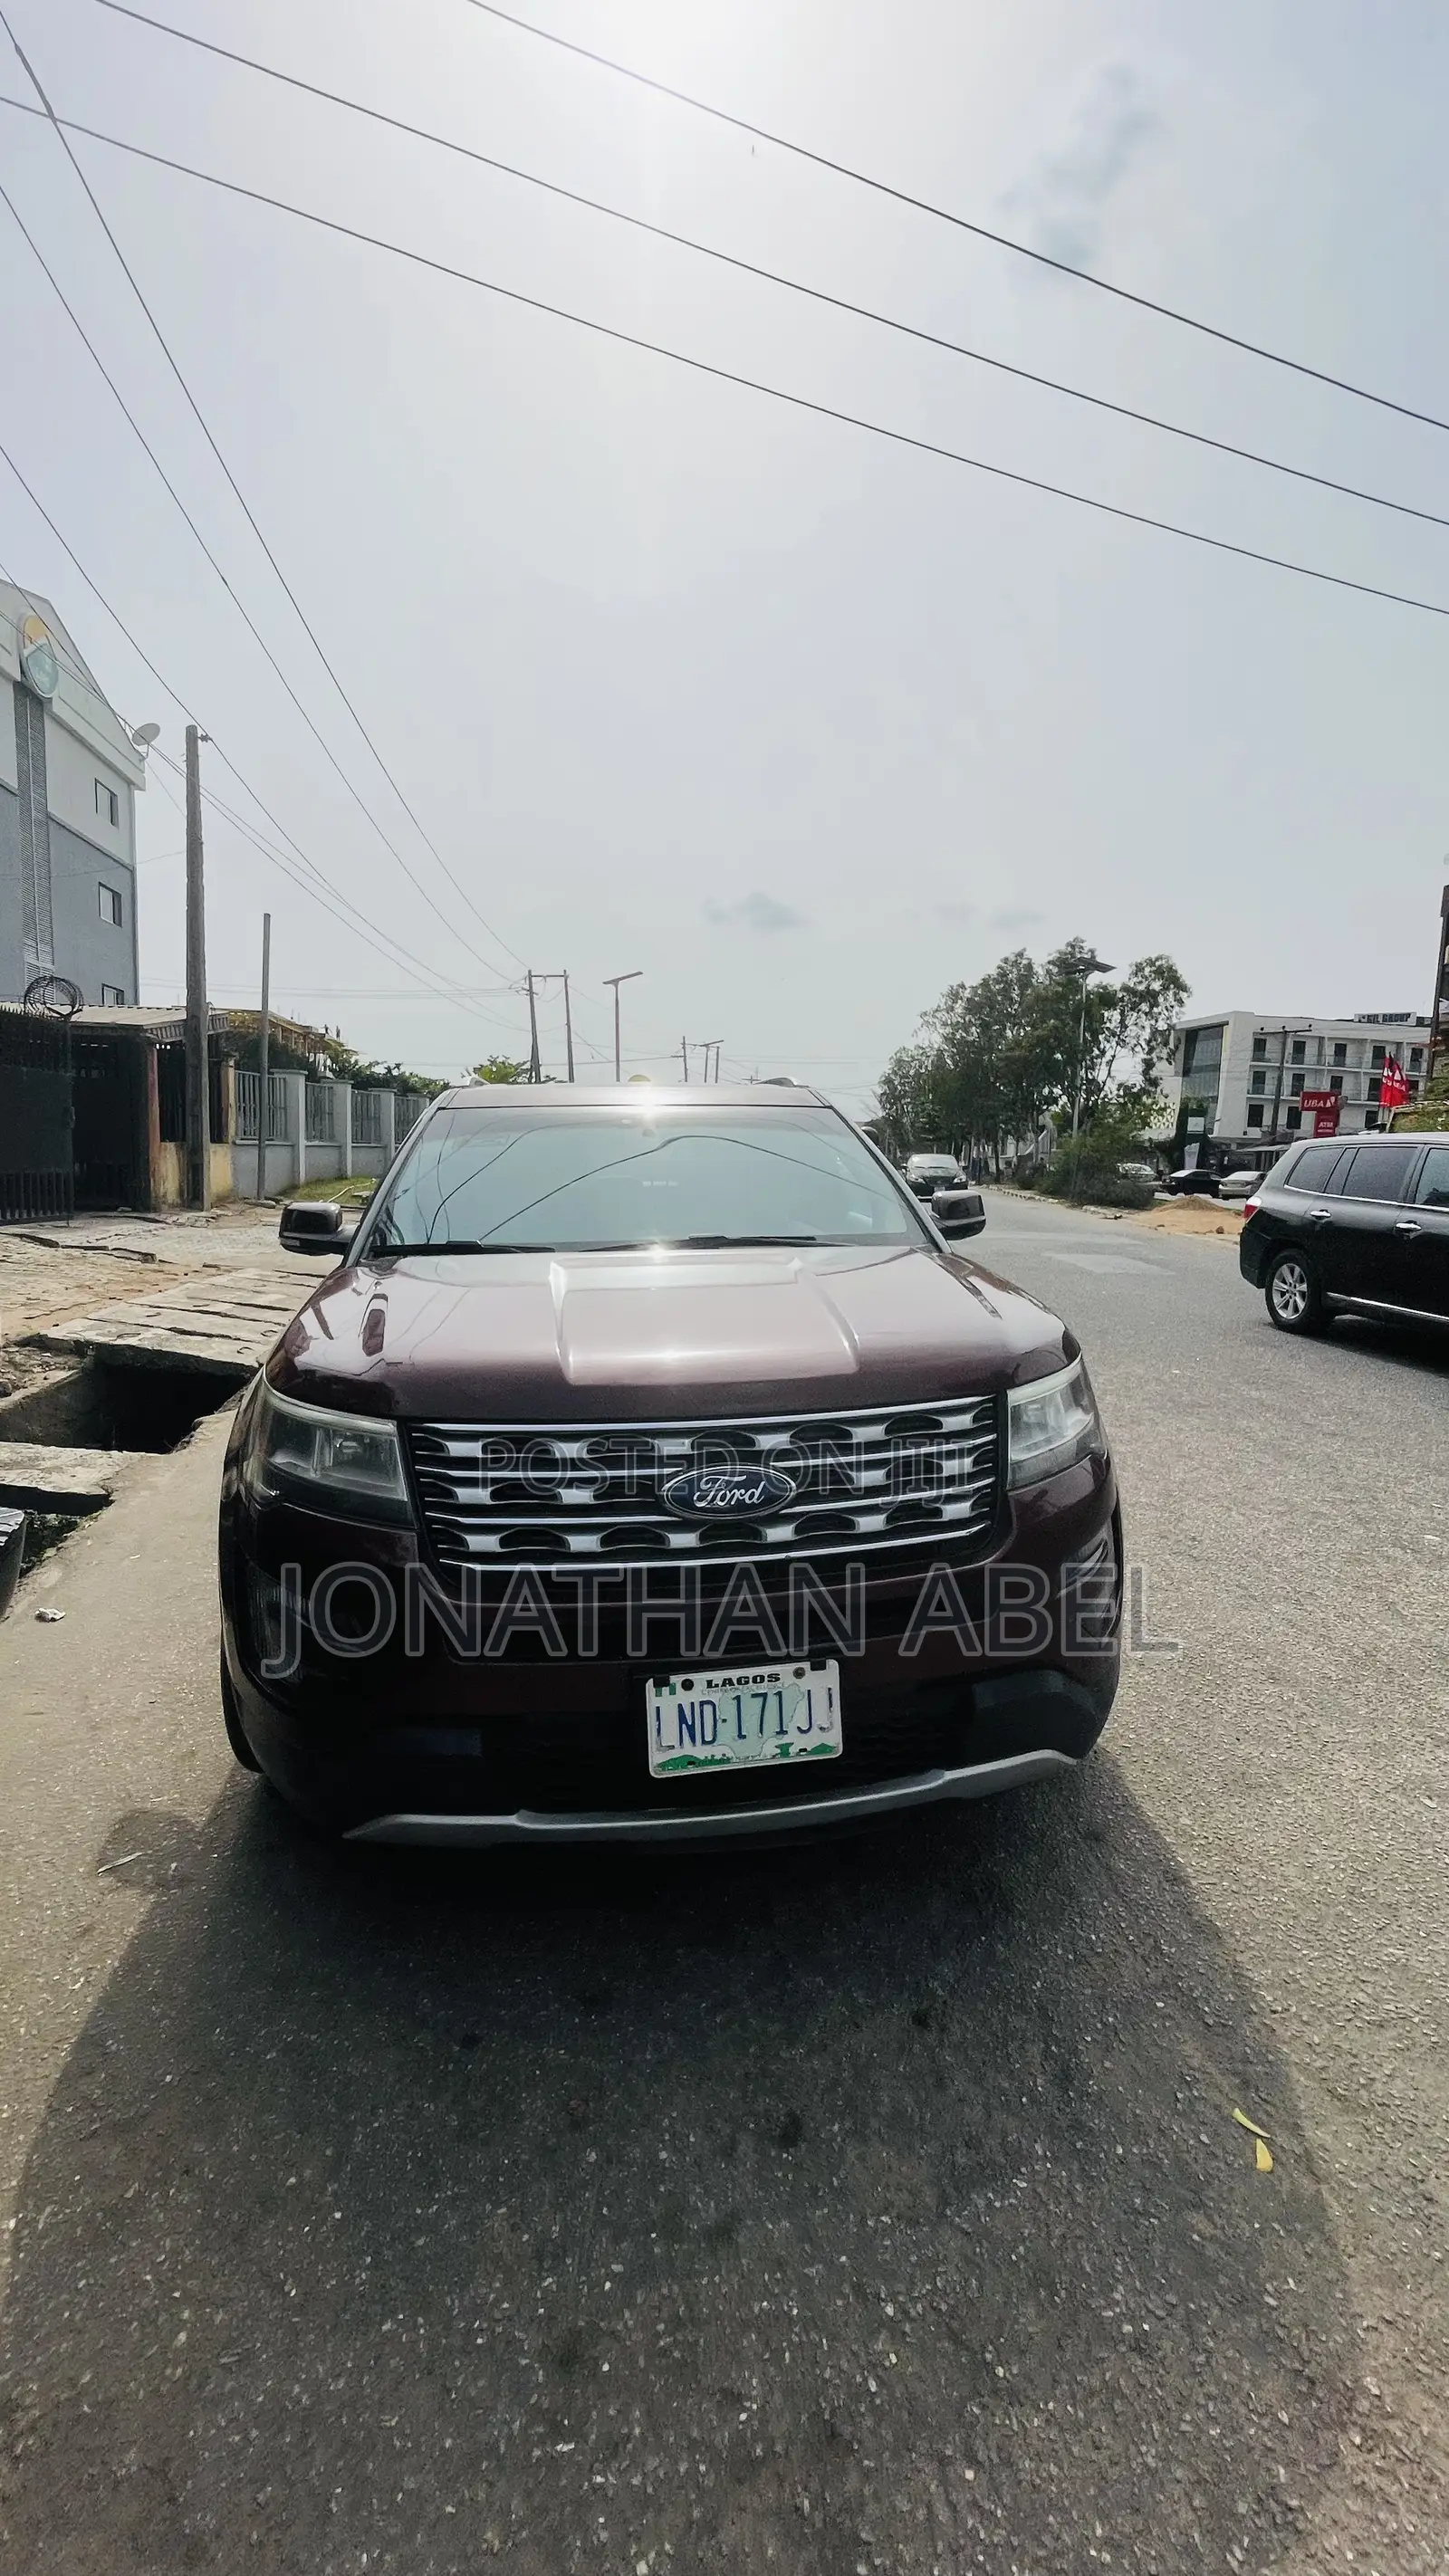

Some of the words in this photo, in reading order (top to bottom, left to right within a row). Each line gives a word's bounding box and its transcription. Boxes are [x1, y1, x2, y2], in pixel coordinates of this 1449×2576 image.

[1303, 1098, 1324, 1108] UBA
[693, 1475, 765, 1508] Ford
[705, 1672, 781, 1690] LAGOS
